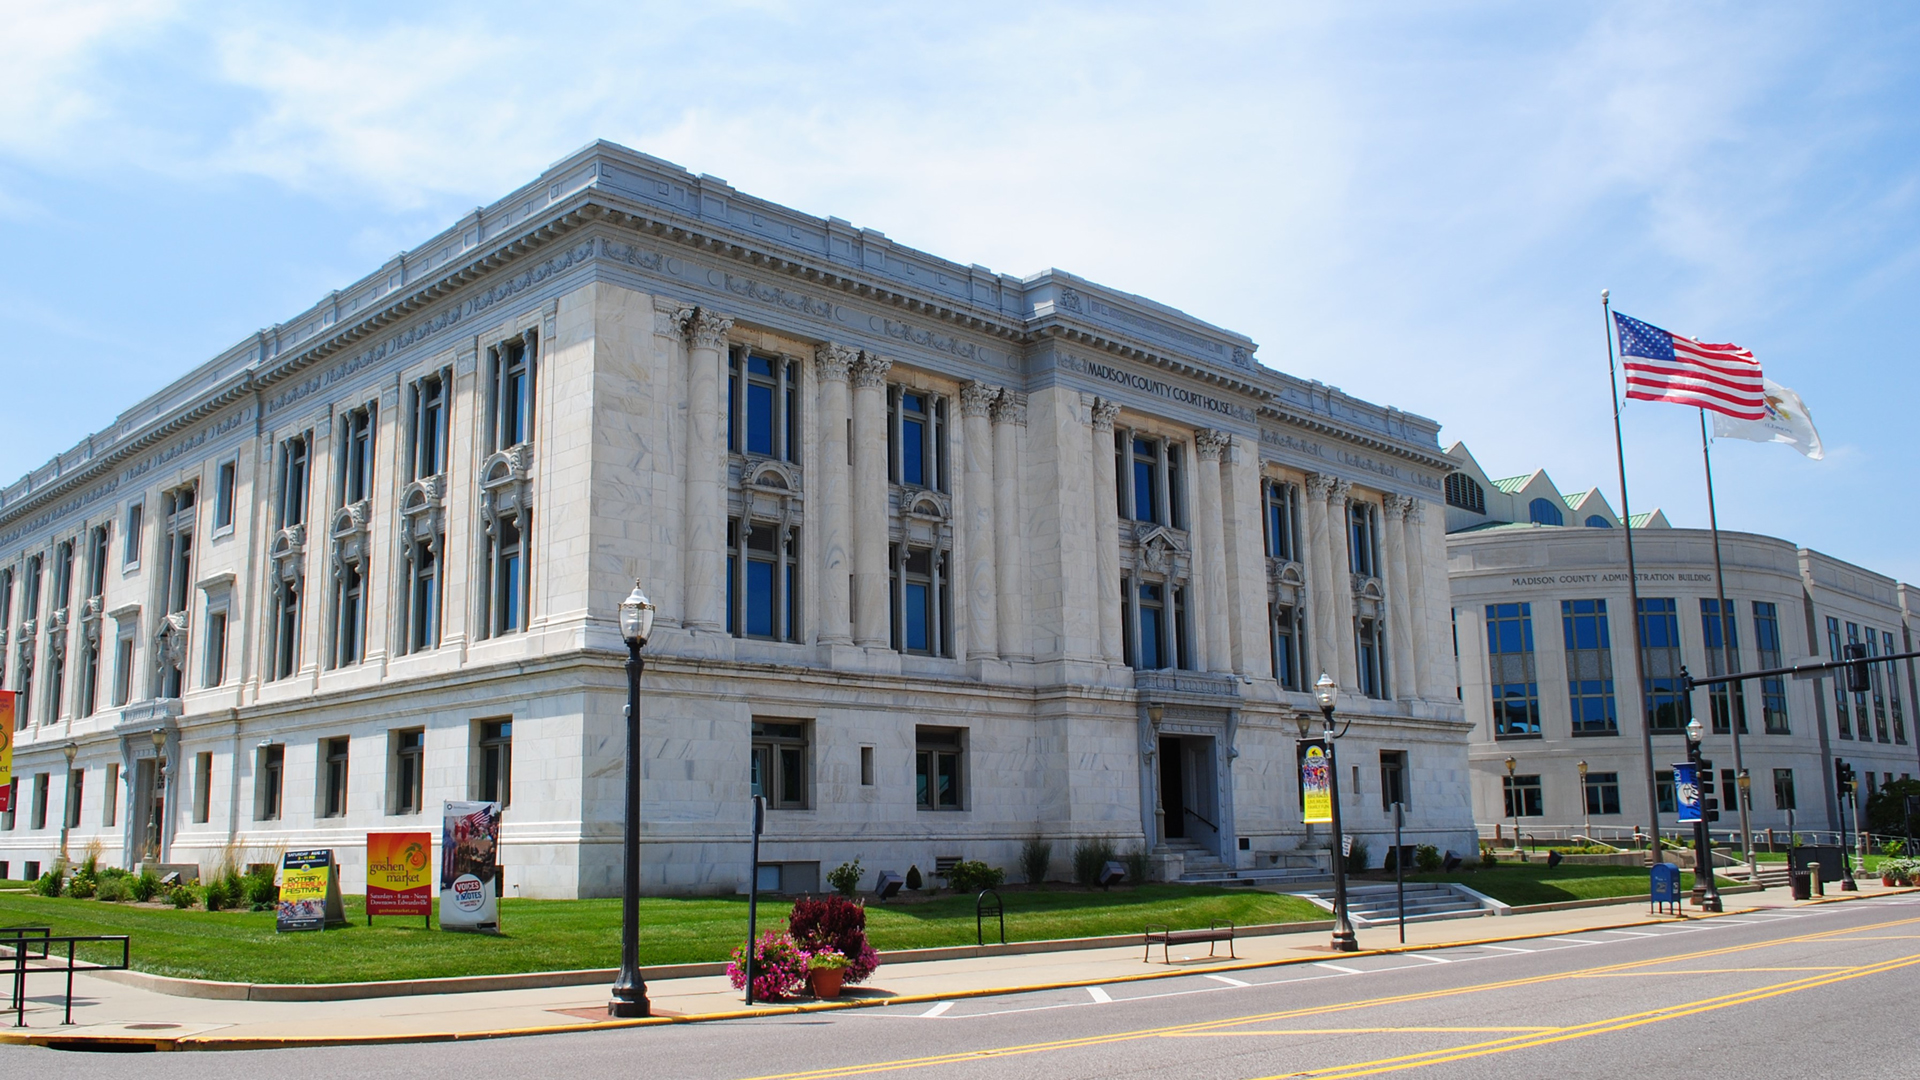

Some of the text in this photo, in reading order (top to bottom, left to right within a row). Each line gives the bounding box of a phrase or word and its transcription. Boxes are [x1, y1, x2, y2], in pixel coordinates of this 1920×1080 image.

[1088, 362, 1131, 386] MADISON
[1132, 375, 1172, 398] COUNTY
[1512, 573, 1712, 586] MADISON COUNTY ADMINSTRATION BUILDING
[369, 856, 405, 876] goshen
[287, 875, 322, 883] ROTARY
[386, 869, 420, 887] market
[282, 880, 327, 889] CRITERIUM
[456, 881, 480, 891] VOICES
[285, 887, 324, 895] FESTIVAL
